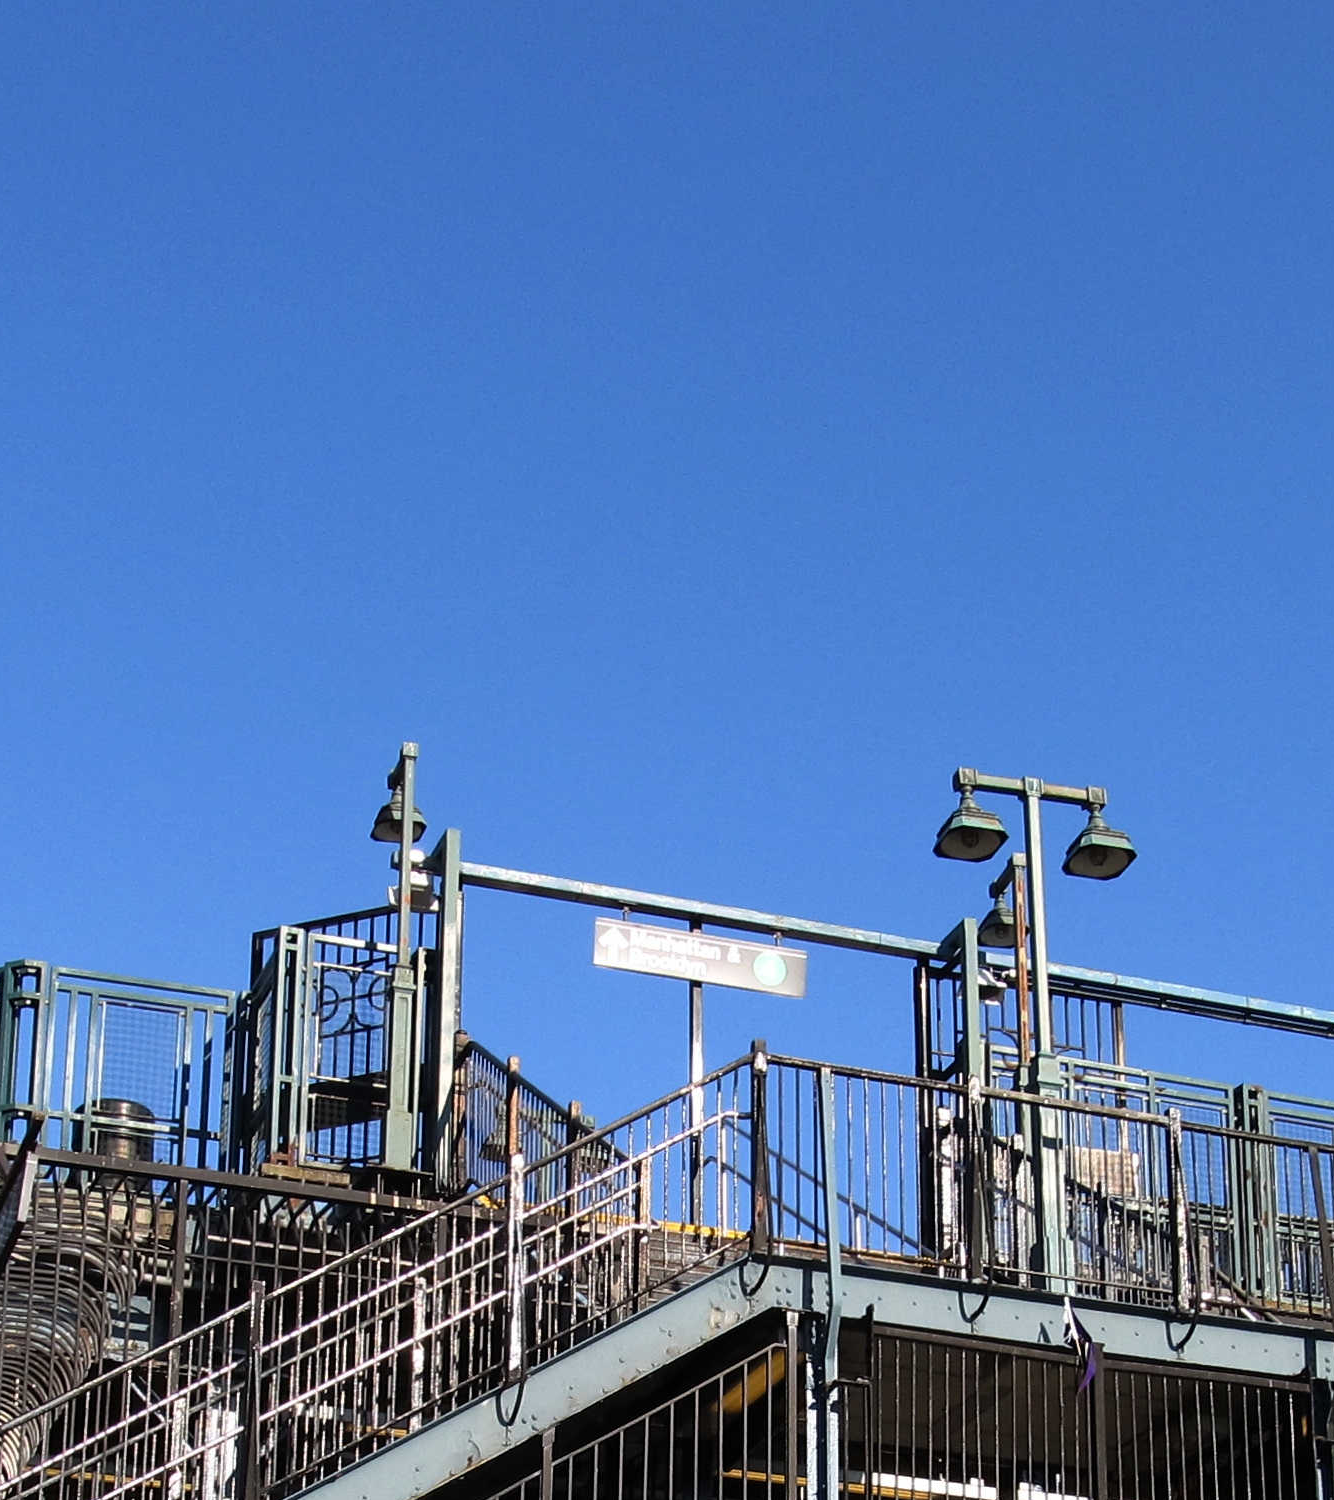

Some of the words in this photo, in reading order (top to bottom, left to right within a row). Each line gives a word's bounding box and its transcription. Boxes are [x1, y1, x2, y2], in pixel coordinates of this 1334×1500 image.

[629, 947, 707, 977] Brooklyn
[630, 928, 721, 960] Manhattan
[726, 946, 741, 965] &
